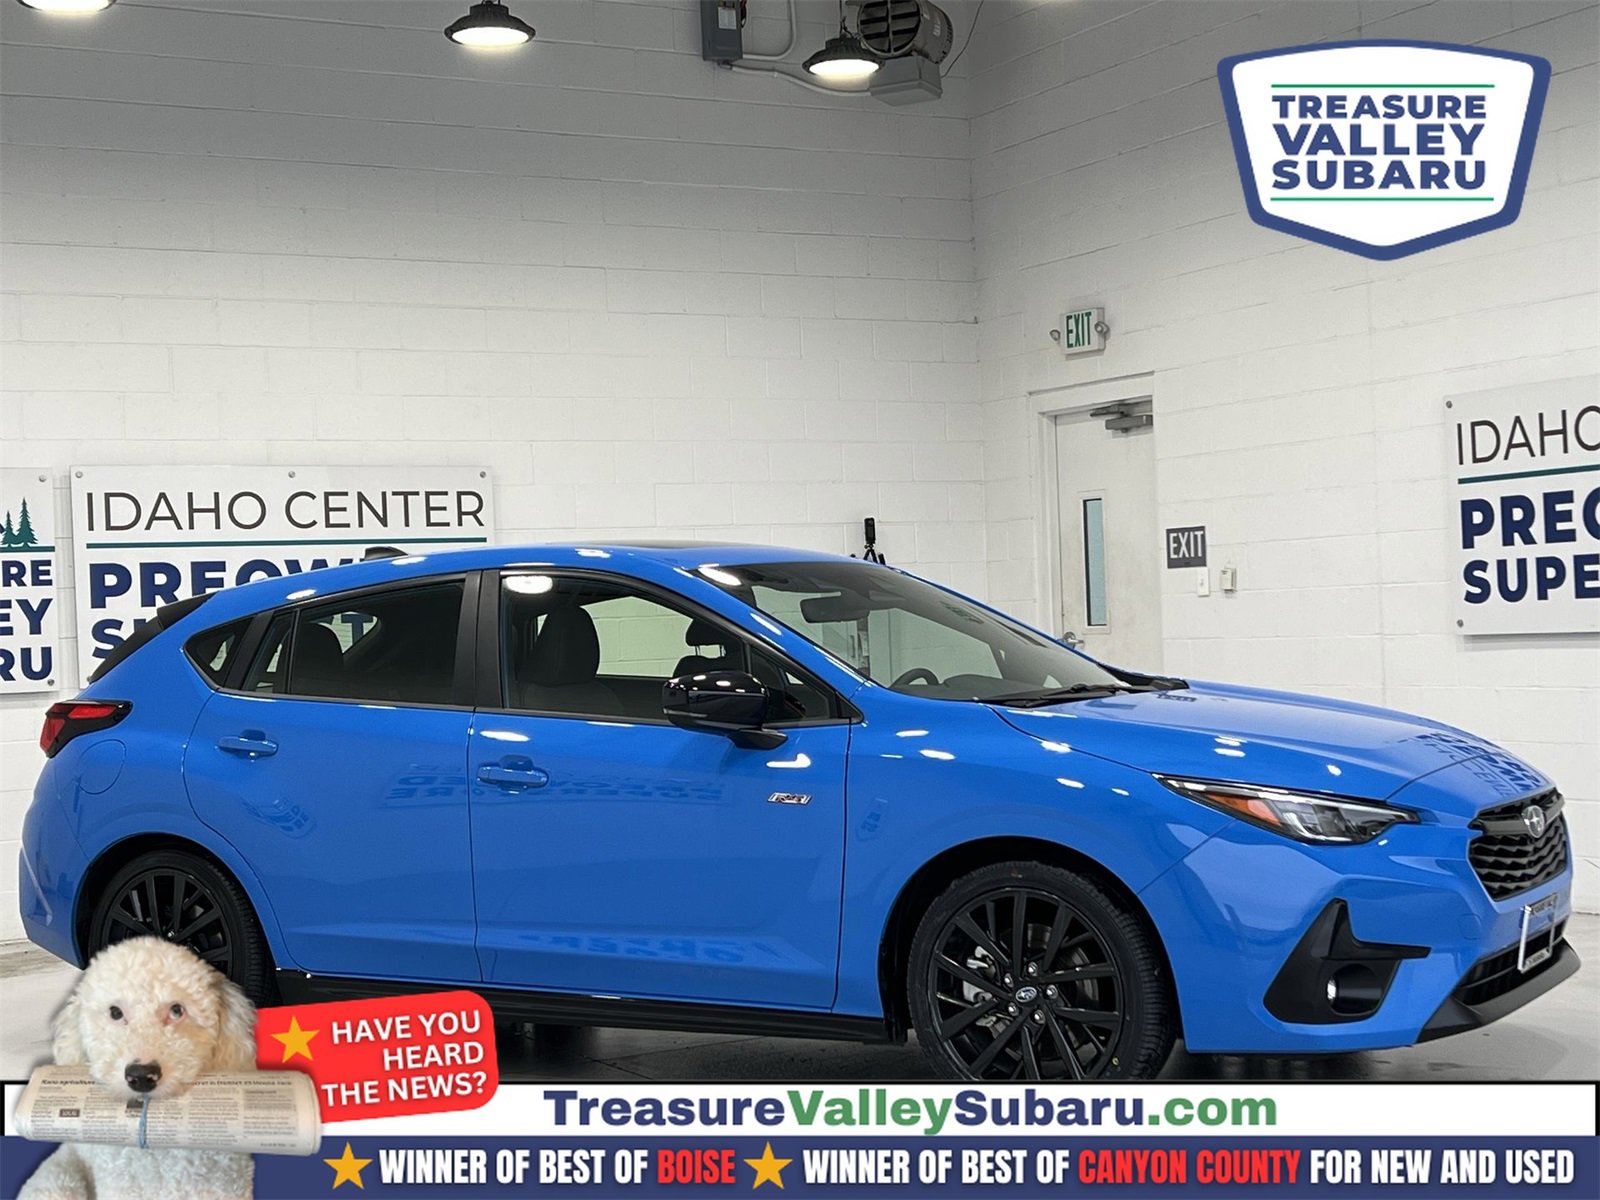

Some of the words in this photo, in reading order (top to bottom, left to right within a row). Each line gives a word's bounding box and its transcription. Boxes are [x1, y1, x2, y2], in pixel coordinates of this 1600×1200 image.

[1066, 311, 1092, 348] EXIT
[1457, 405, 1600, 465] IDAHO
[86, 491, 266, 531] IDAHO
[284, 490, 484, 529] CENTER
[1169, 531, 1204, 559] EXIT
[1463, 554, 1600, 604] SUPE
